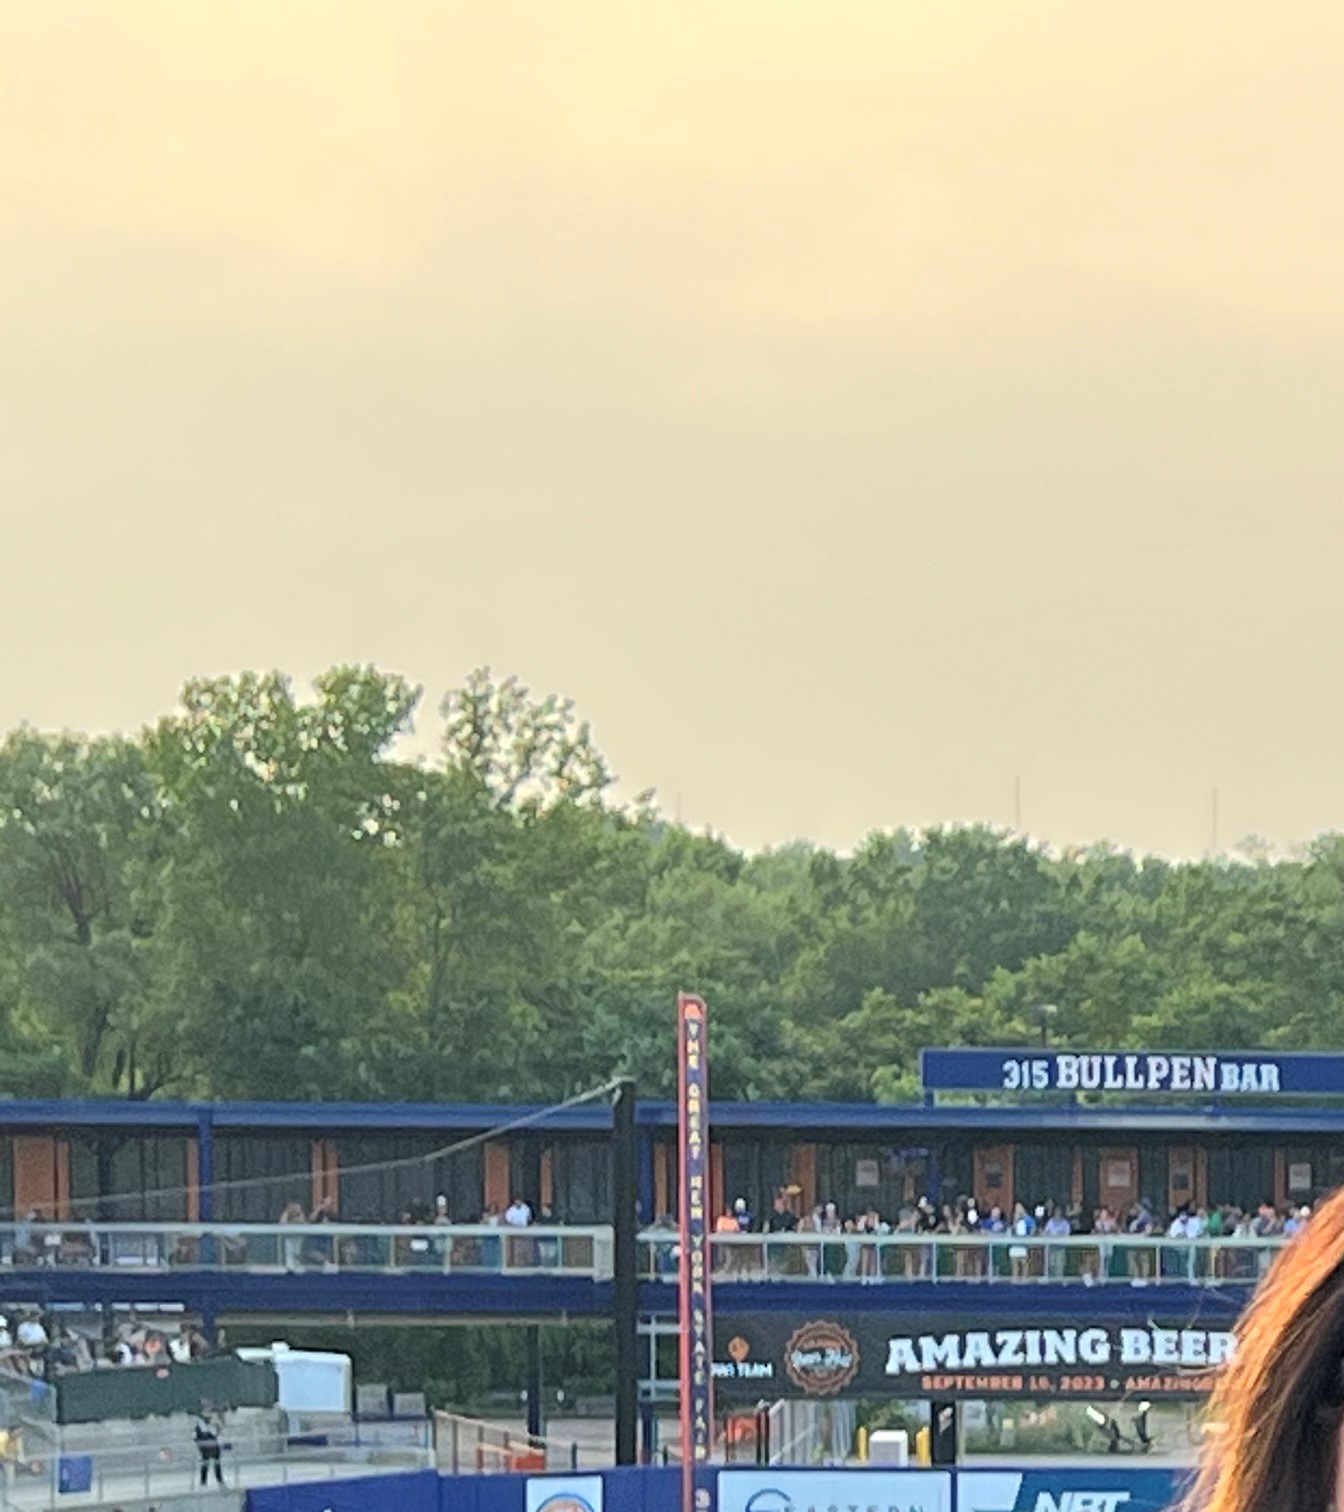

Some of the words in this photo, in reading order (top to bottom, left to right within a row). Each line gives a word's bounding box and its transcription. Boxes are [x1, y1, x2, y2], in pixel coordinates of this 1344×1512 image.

[1002, 1060, 1049, 1089] 315
[1056, 1055, 1217, 1090] BULLPEN
[1220, 1063, 1280, 1092] BAR
[885, 1328, 1112, 1375] AMAZING
[1120, 1328, 1239, 1367] BEER
[921, 1375, 1024, 1391] SEPTEMBER
[1060, 1375, 1106, 1391] 2023
